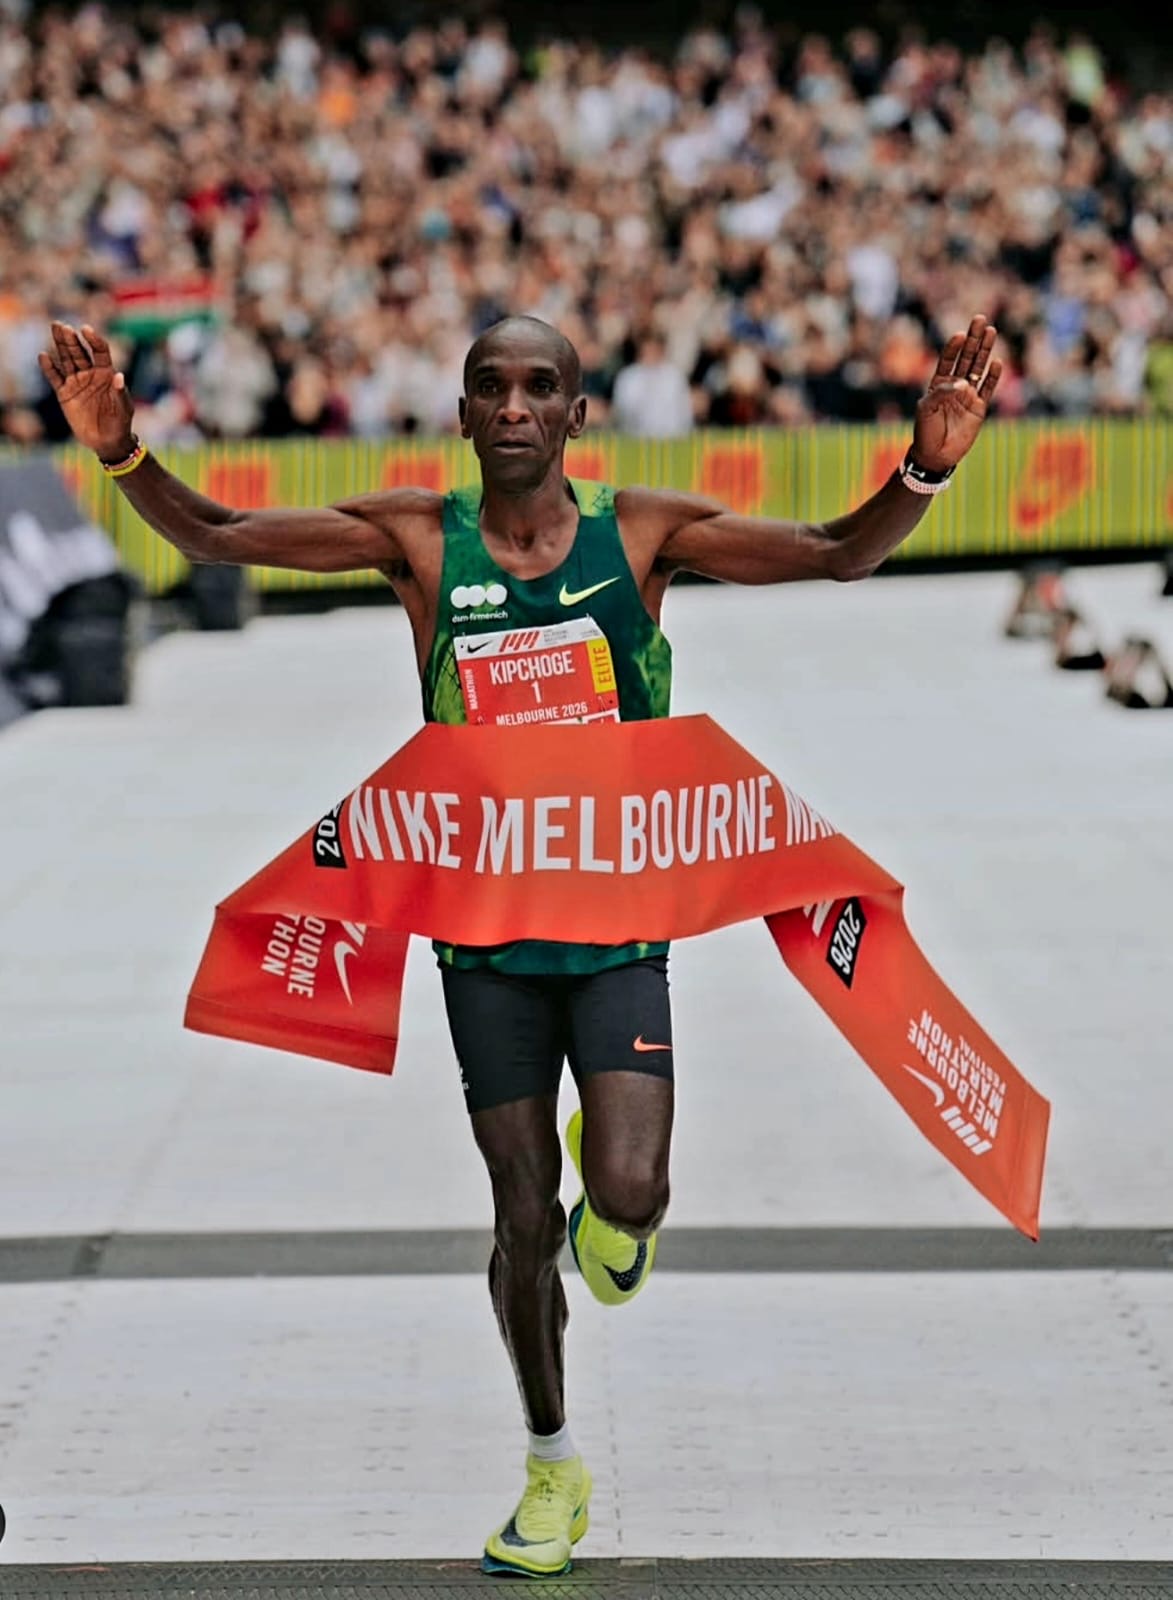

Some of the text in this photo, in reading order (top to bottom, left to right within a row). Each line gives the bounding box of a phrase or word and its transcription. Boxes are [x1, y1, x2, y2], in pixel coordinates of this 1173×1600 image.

[489, 651, 575, 685] KIPCHOGE
[530, 682, 542, 704] 1
[592, 645, 612, 684] ELITE
[496, 702, 589, 726] MELBOURNE 2026
[348, 786, 462, 869] NIKE
[475, 774, 776, 875] MELBOURNE
[830, 903, 861, 975] 2026
[907, 1018, 998, 1139] MELBOURNE
[920, 1009, 1004, 1117] MARATHON
[959, 1035, 1007, 1096] FESTIVAL
